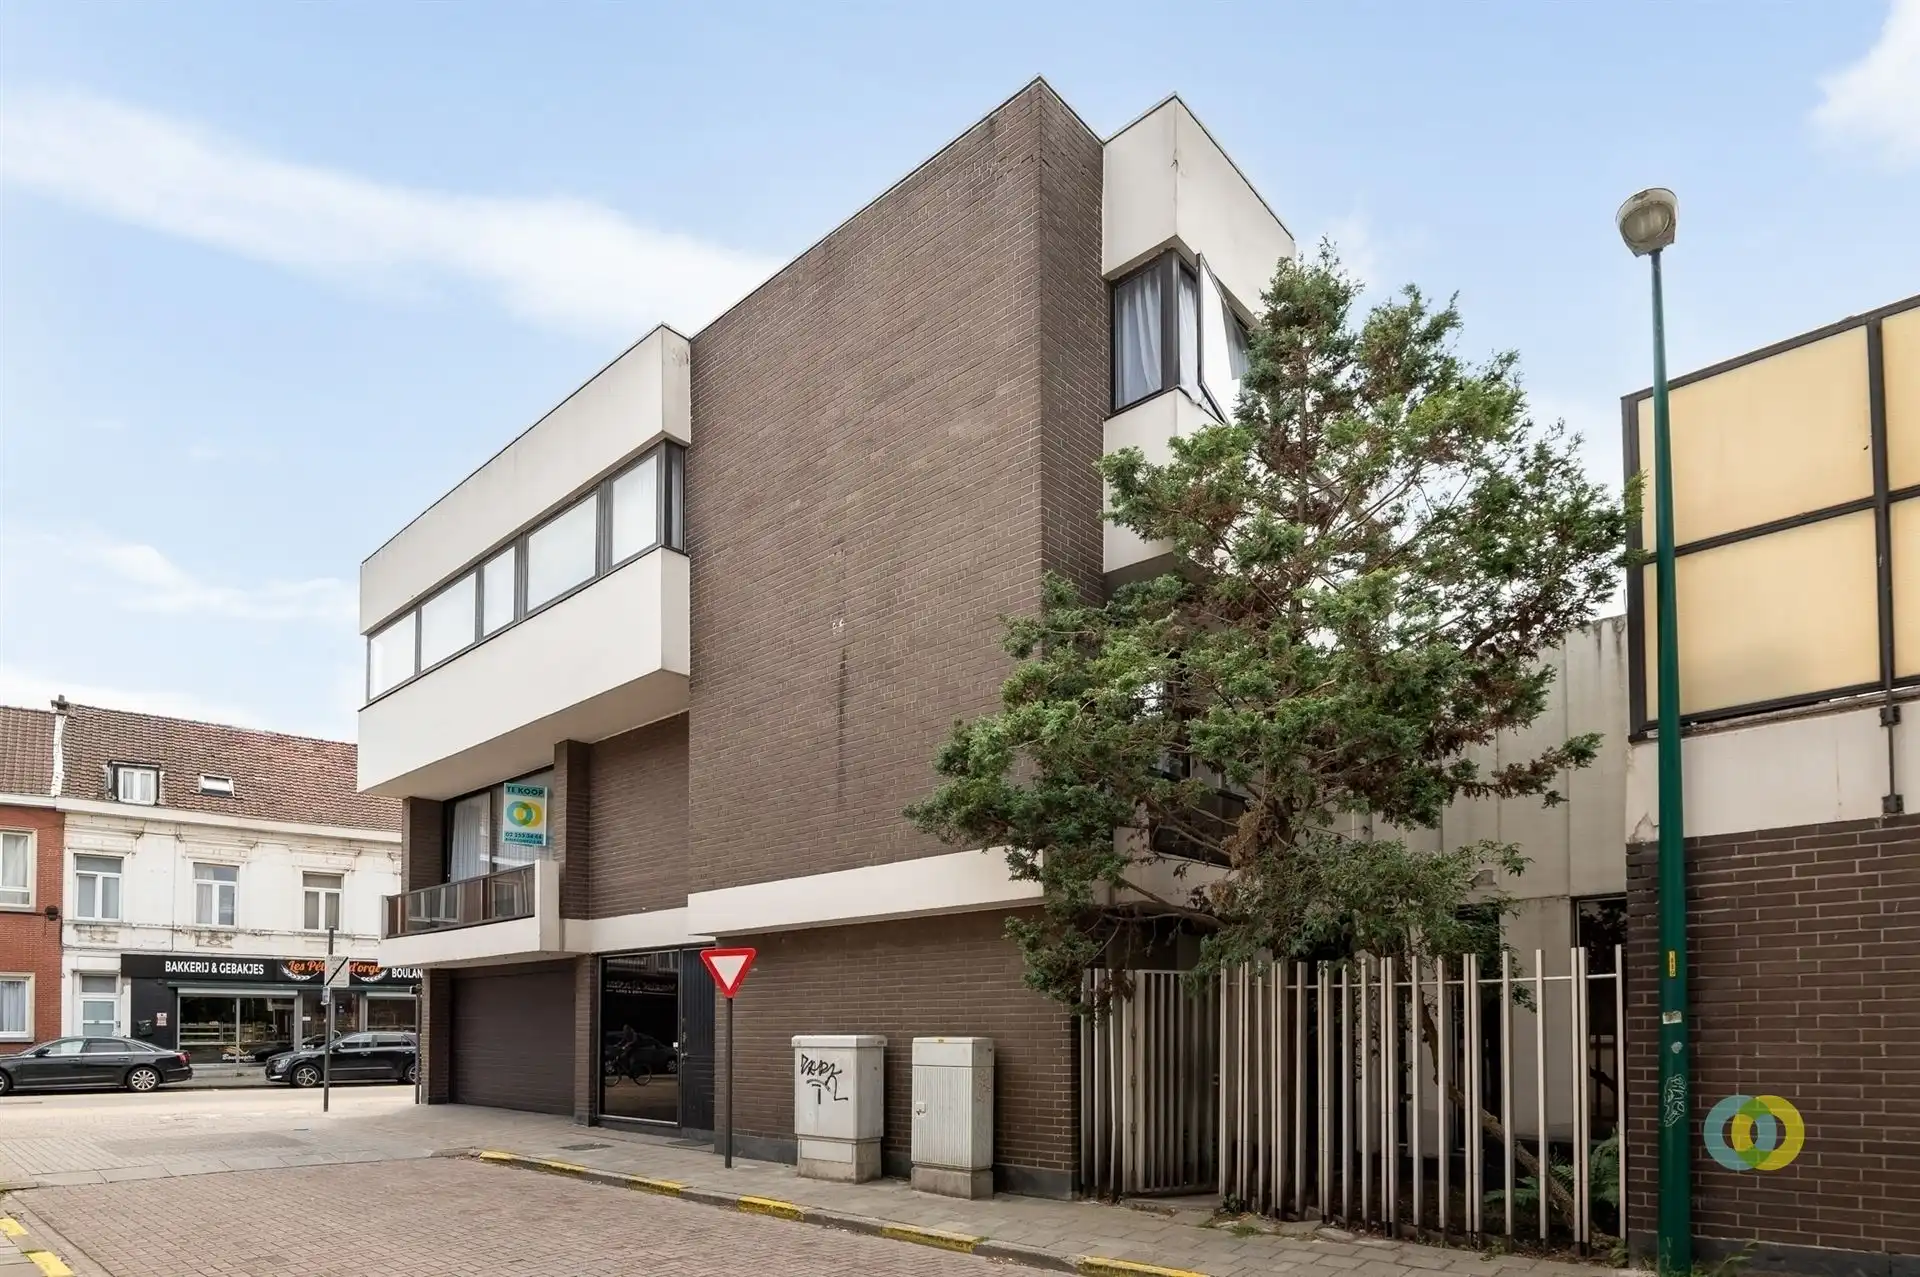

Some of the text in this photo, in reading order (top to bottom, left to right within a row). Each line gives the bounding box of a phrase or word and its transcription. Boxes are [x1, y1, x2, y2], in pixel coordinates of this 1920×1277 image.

[518, 787, 544, 796] KOOP
[165, 960, 264, 975] BAKKERIJ & GEBAKJES
[288, 960, 305, 973] Les
[307, 960, 325, 971] Pét
